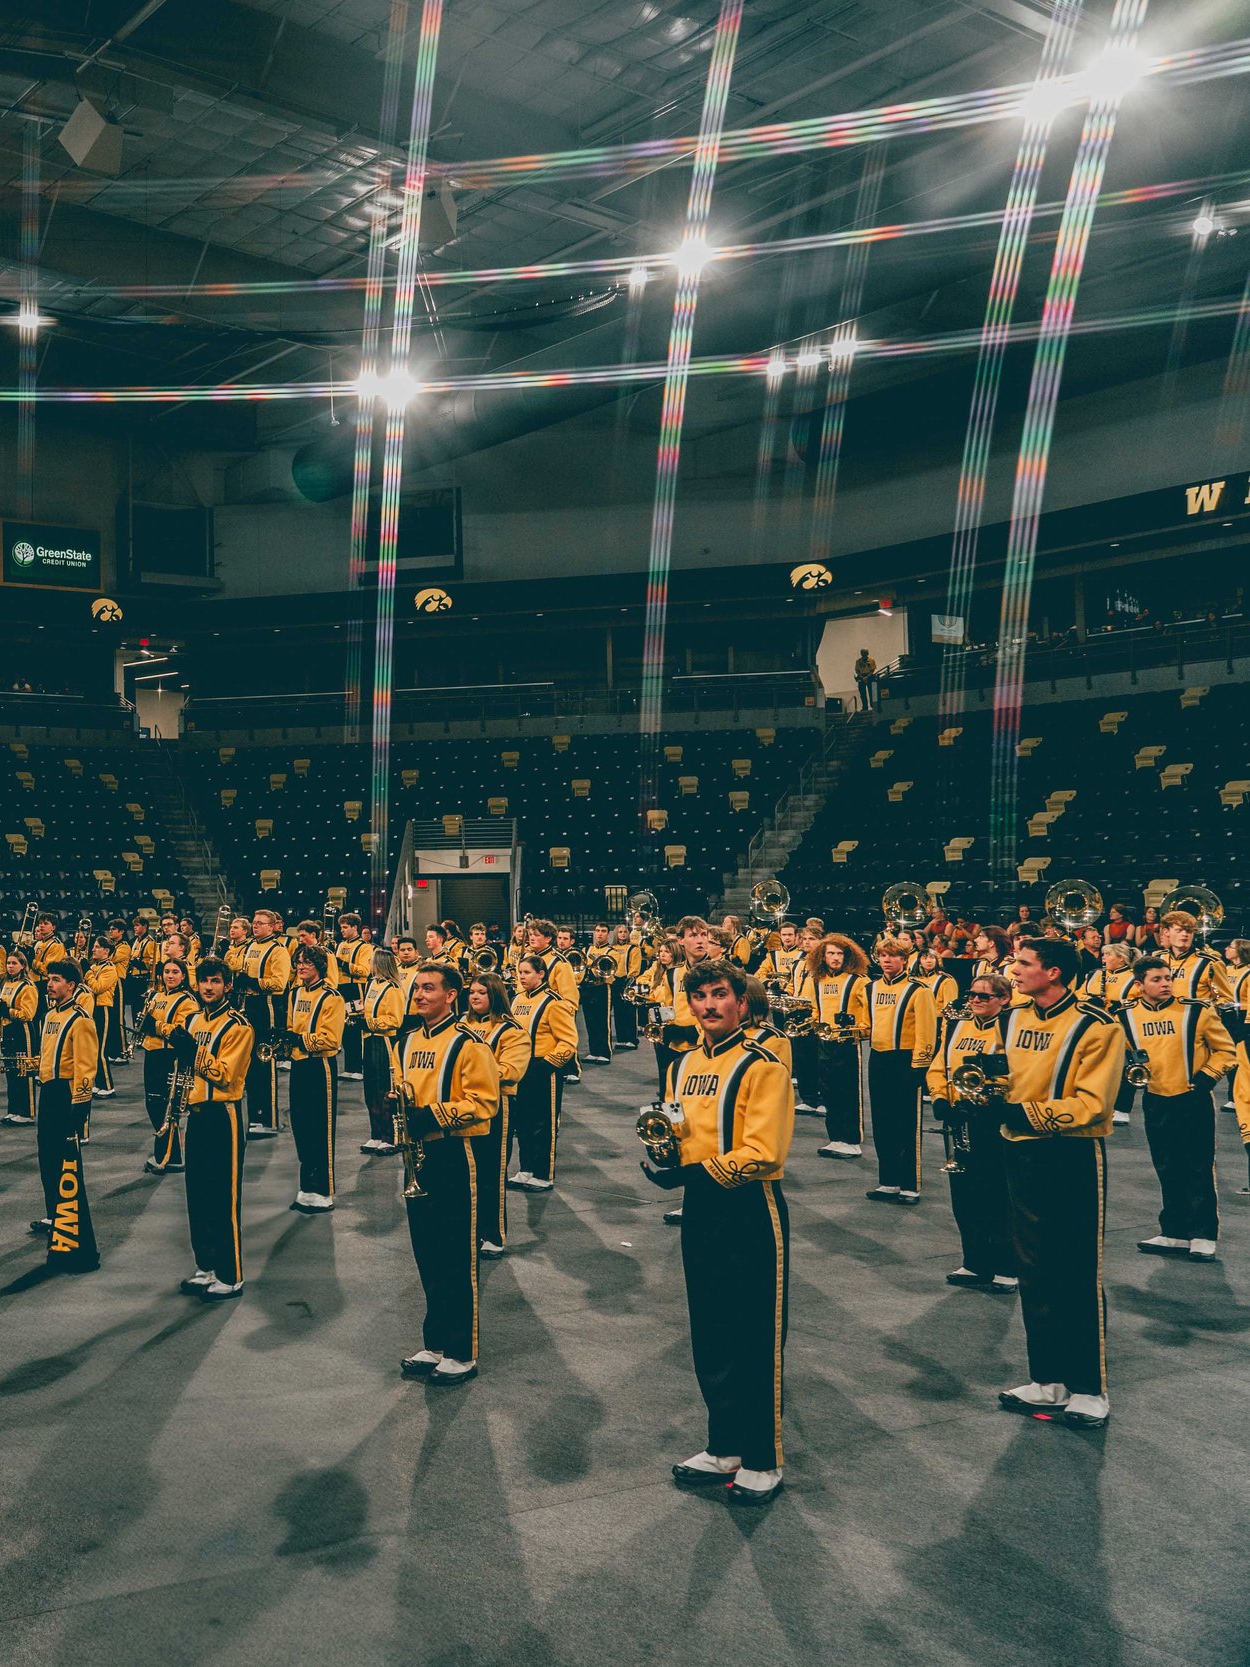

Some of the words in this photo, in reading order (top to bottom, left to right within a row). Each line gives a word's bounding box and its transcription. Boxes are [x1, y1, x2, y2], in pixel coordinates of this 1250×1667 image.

[36, 546, 92, 562] GreenState
[42, 558, 65, 566] CREDIT
[66, 560, 87, 568] UNION
[823, 983, 839, 995] IOWA
[876, 992, 897, 1005] IOWA
[1142, 1020, 1176, 1037] IOWA
[955, 1037, 987, 1052] IOWA
[408, 1050, 436, 1070] IOWA
[682, 1074, 720, 1096] IOWA
[50, 1159, 80, 1252] IOWA
